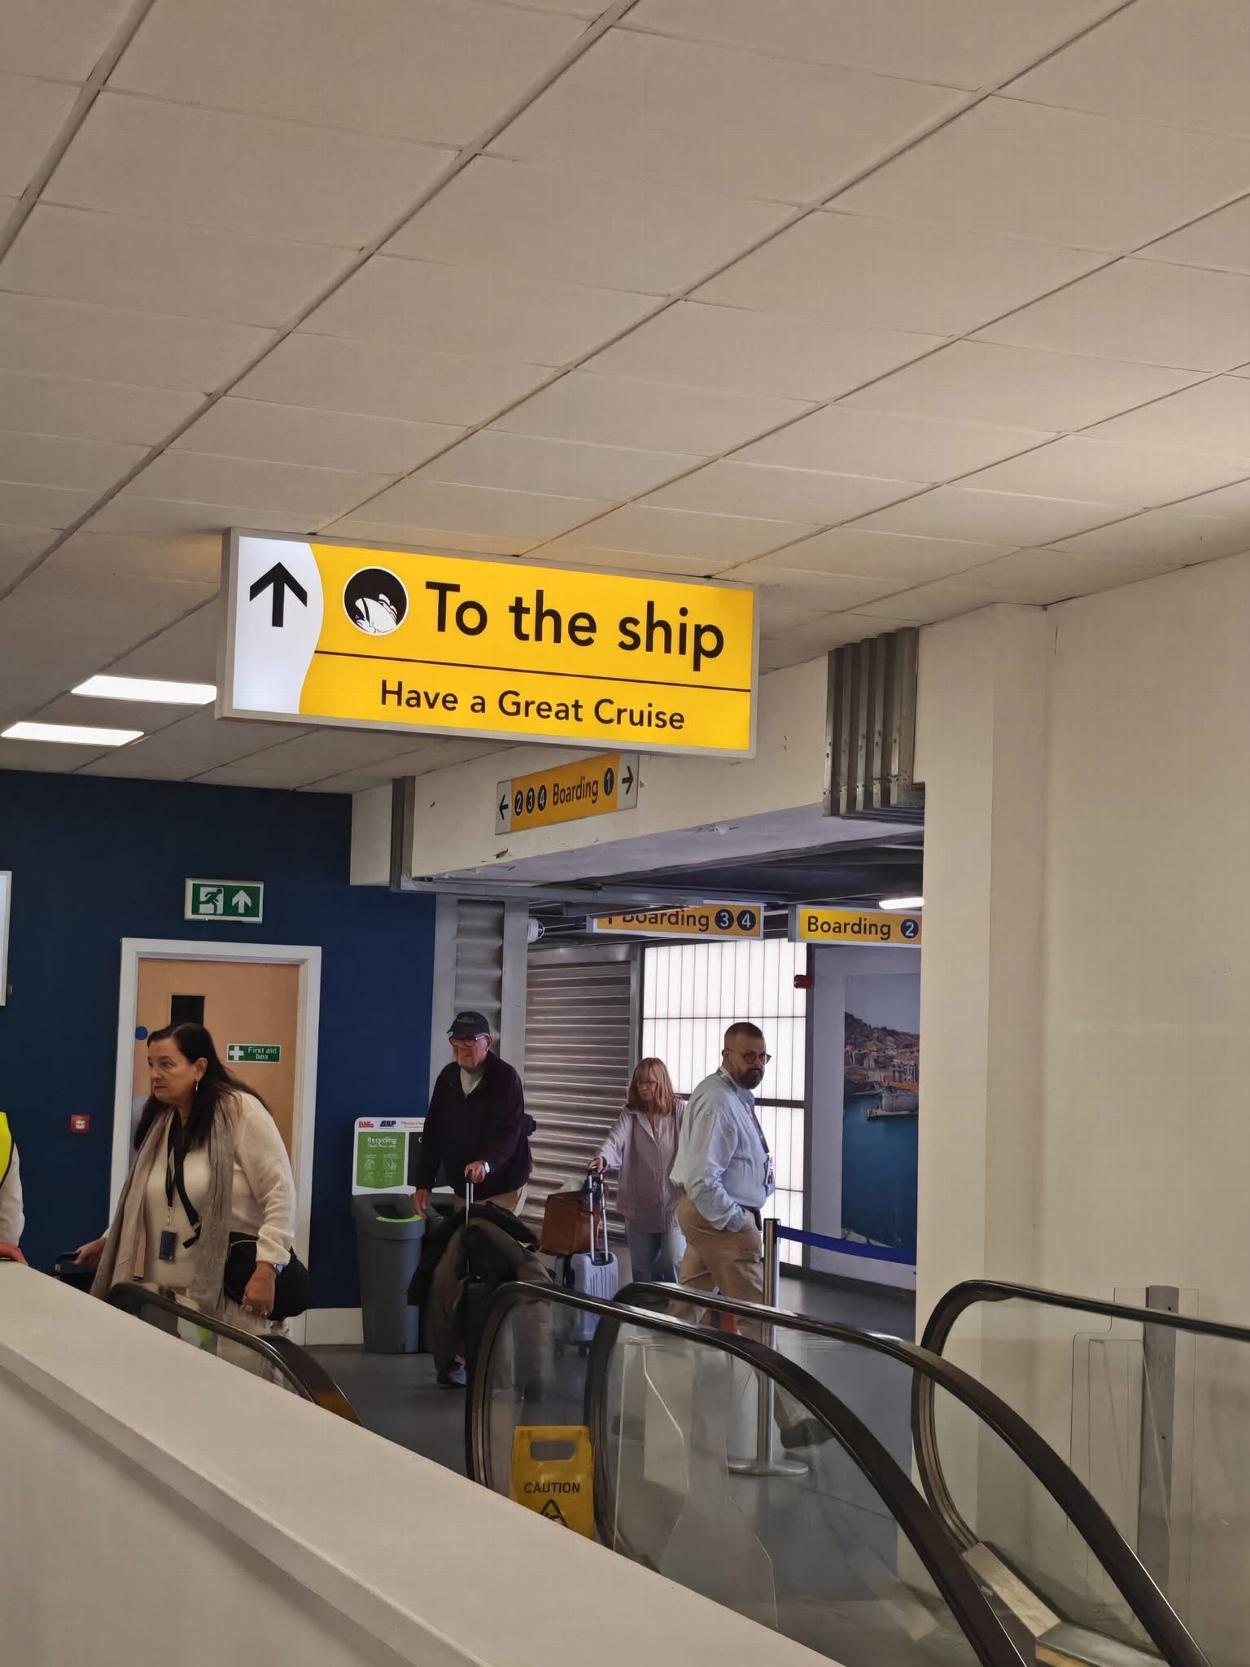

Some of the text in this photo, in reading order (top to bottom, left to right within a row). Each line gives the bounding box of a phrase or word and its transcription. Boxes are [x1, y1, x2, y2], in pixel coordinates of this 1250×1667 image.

[426, 582, 724, 672] To the ship
[381, 679, 685, 730] Have a Great Cruise
[552, 775, 599, 806] Boarding
[807, 915, 891, 940] Boarding
[247, 1046, 264, 1054] First
[523, 1481, 581, 1494] CAUTION
